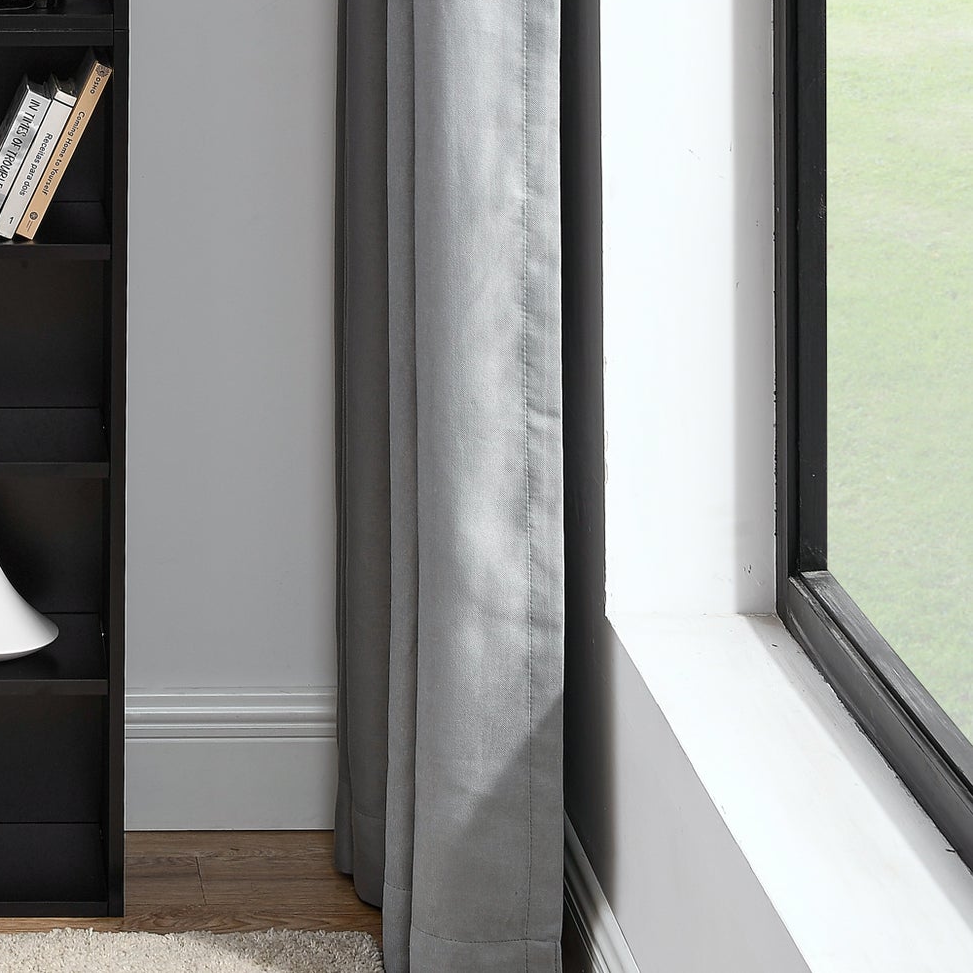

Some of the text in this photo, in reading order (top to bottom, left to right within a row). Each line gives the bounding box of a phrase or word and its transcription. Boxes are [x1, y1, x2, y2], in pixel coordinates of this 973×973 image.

[90, 77, 101, 94] OSHO
[28, 98, 41, 111] IN
[16, 112, 36, 137] TIMES
[11, 137, 23, 150] OF
[42, 111, 85, 196] Coming Home to Yourself
[19, 132, 53, 196] Receitas para dois
